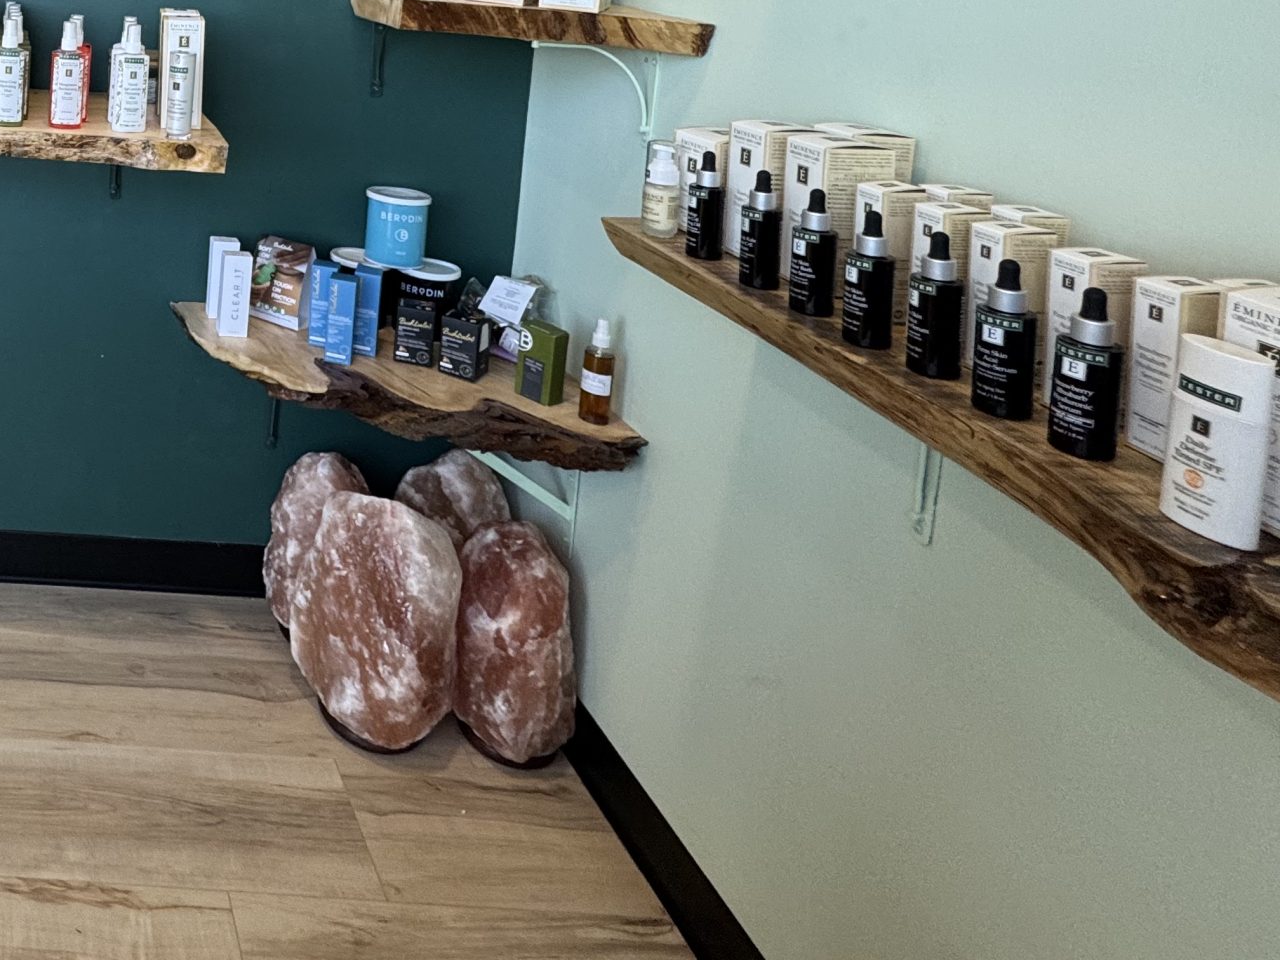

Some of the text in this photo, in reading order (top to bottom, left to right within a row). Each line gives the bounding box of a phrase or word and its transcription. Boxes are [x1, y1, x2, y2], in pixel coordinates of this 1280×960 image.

[401, 282, 445, 298] BERODIN
[231, 284, 241, 321] CLEAR
[976, 311, 1021, 329] TESTER
[1056, 344, 1106, 363] TESTER
[1180, 379, 1238, 407] TESTER
